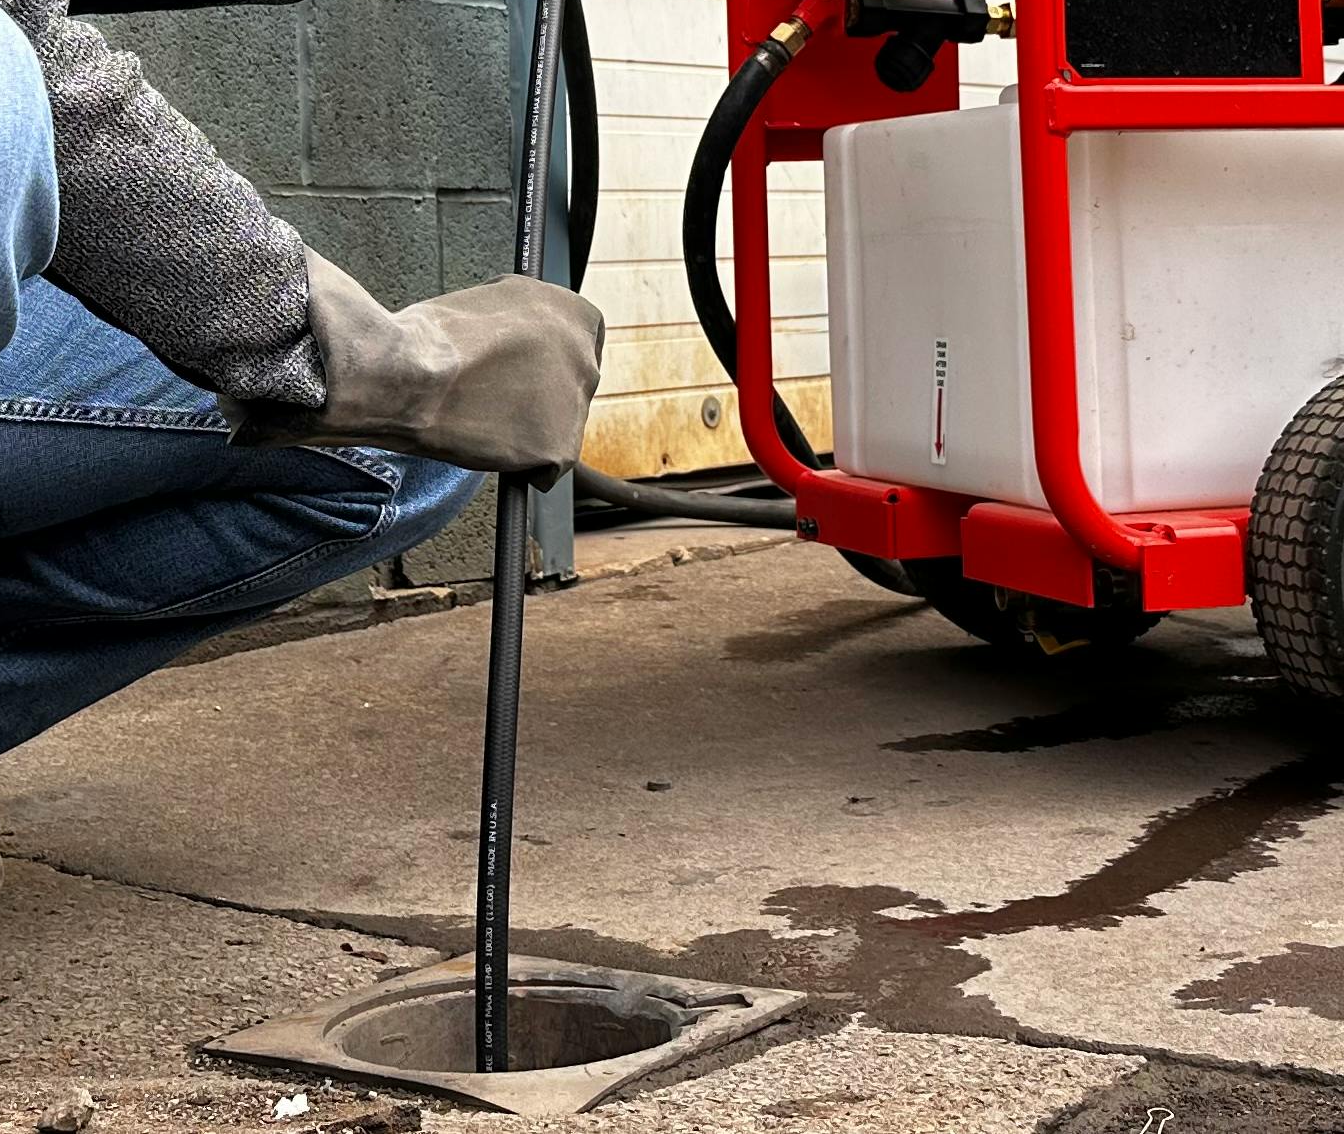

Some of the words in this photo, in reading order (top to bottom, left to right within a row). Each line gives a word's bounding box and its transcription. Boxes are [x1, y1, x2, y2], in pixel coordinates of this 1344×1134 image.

[532, 96, 541, 114] MAX
[525, 172, 535, 213] CLEANERS
[521, 234, 531, 271] GENERAL
[488, 830, 497, 843] IN
[487, 846, 496, 876] MADE
[484, 963, 493, 990] TEMP
[484, 994, 493, 1018] MAX
